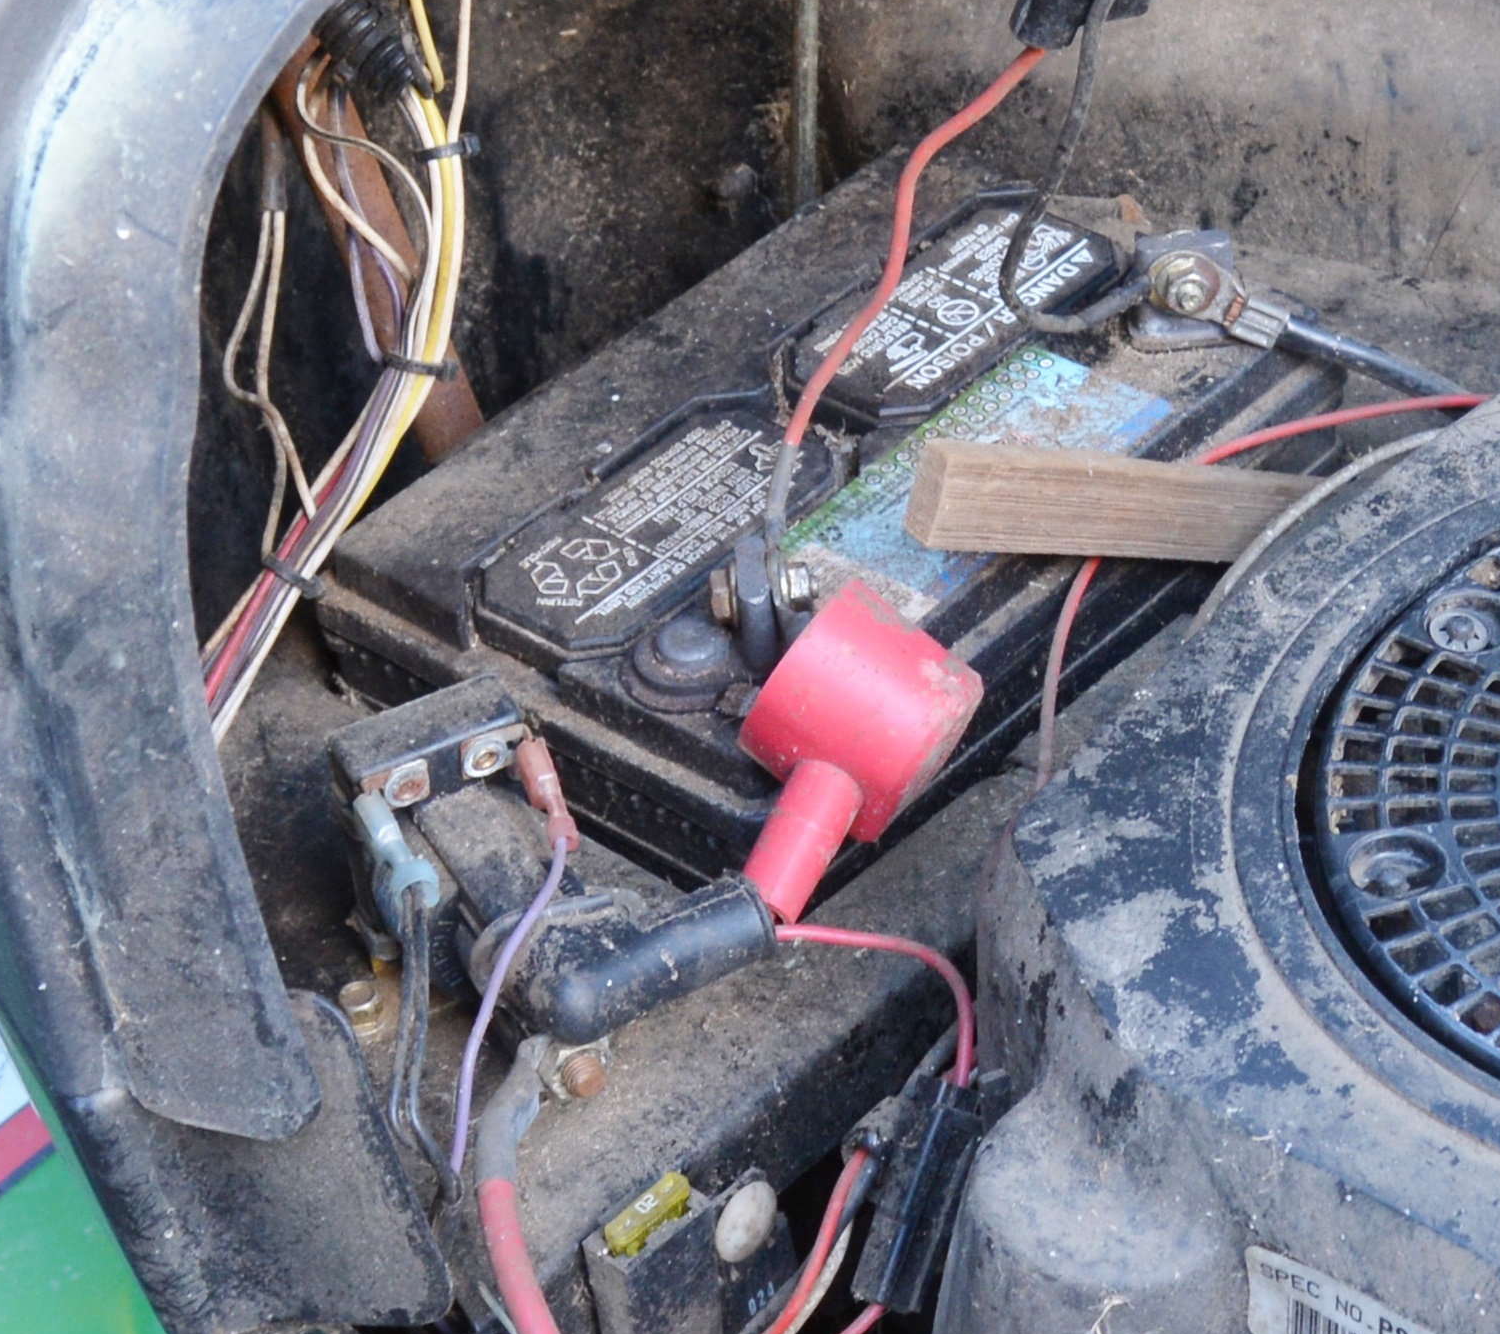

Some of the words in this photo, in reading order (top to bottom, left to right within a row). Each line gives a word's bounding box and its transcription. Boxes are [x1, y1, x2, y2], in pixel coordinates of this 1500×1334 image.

[923, 293, 950, 309] NO
[991, 262, 1081, 325] DANGR
[900, 333, 988, 390] POISON
[623, 578, 645, 595] AND
[1258, 1261, 1320, 1300] SPEC
